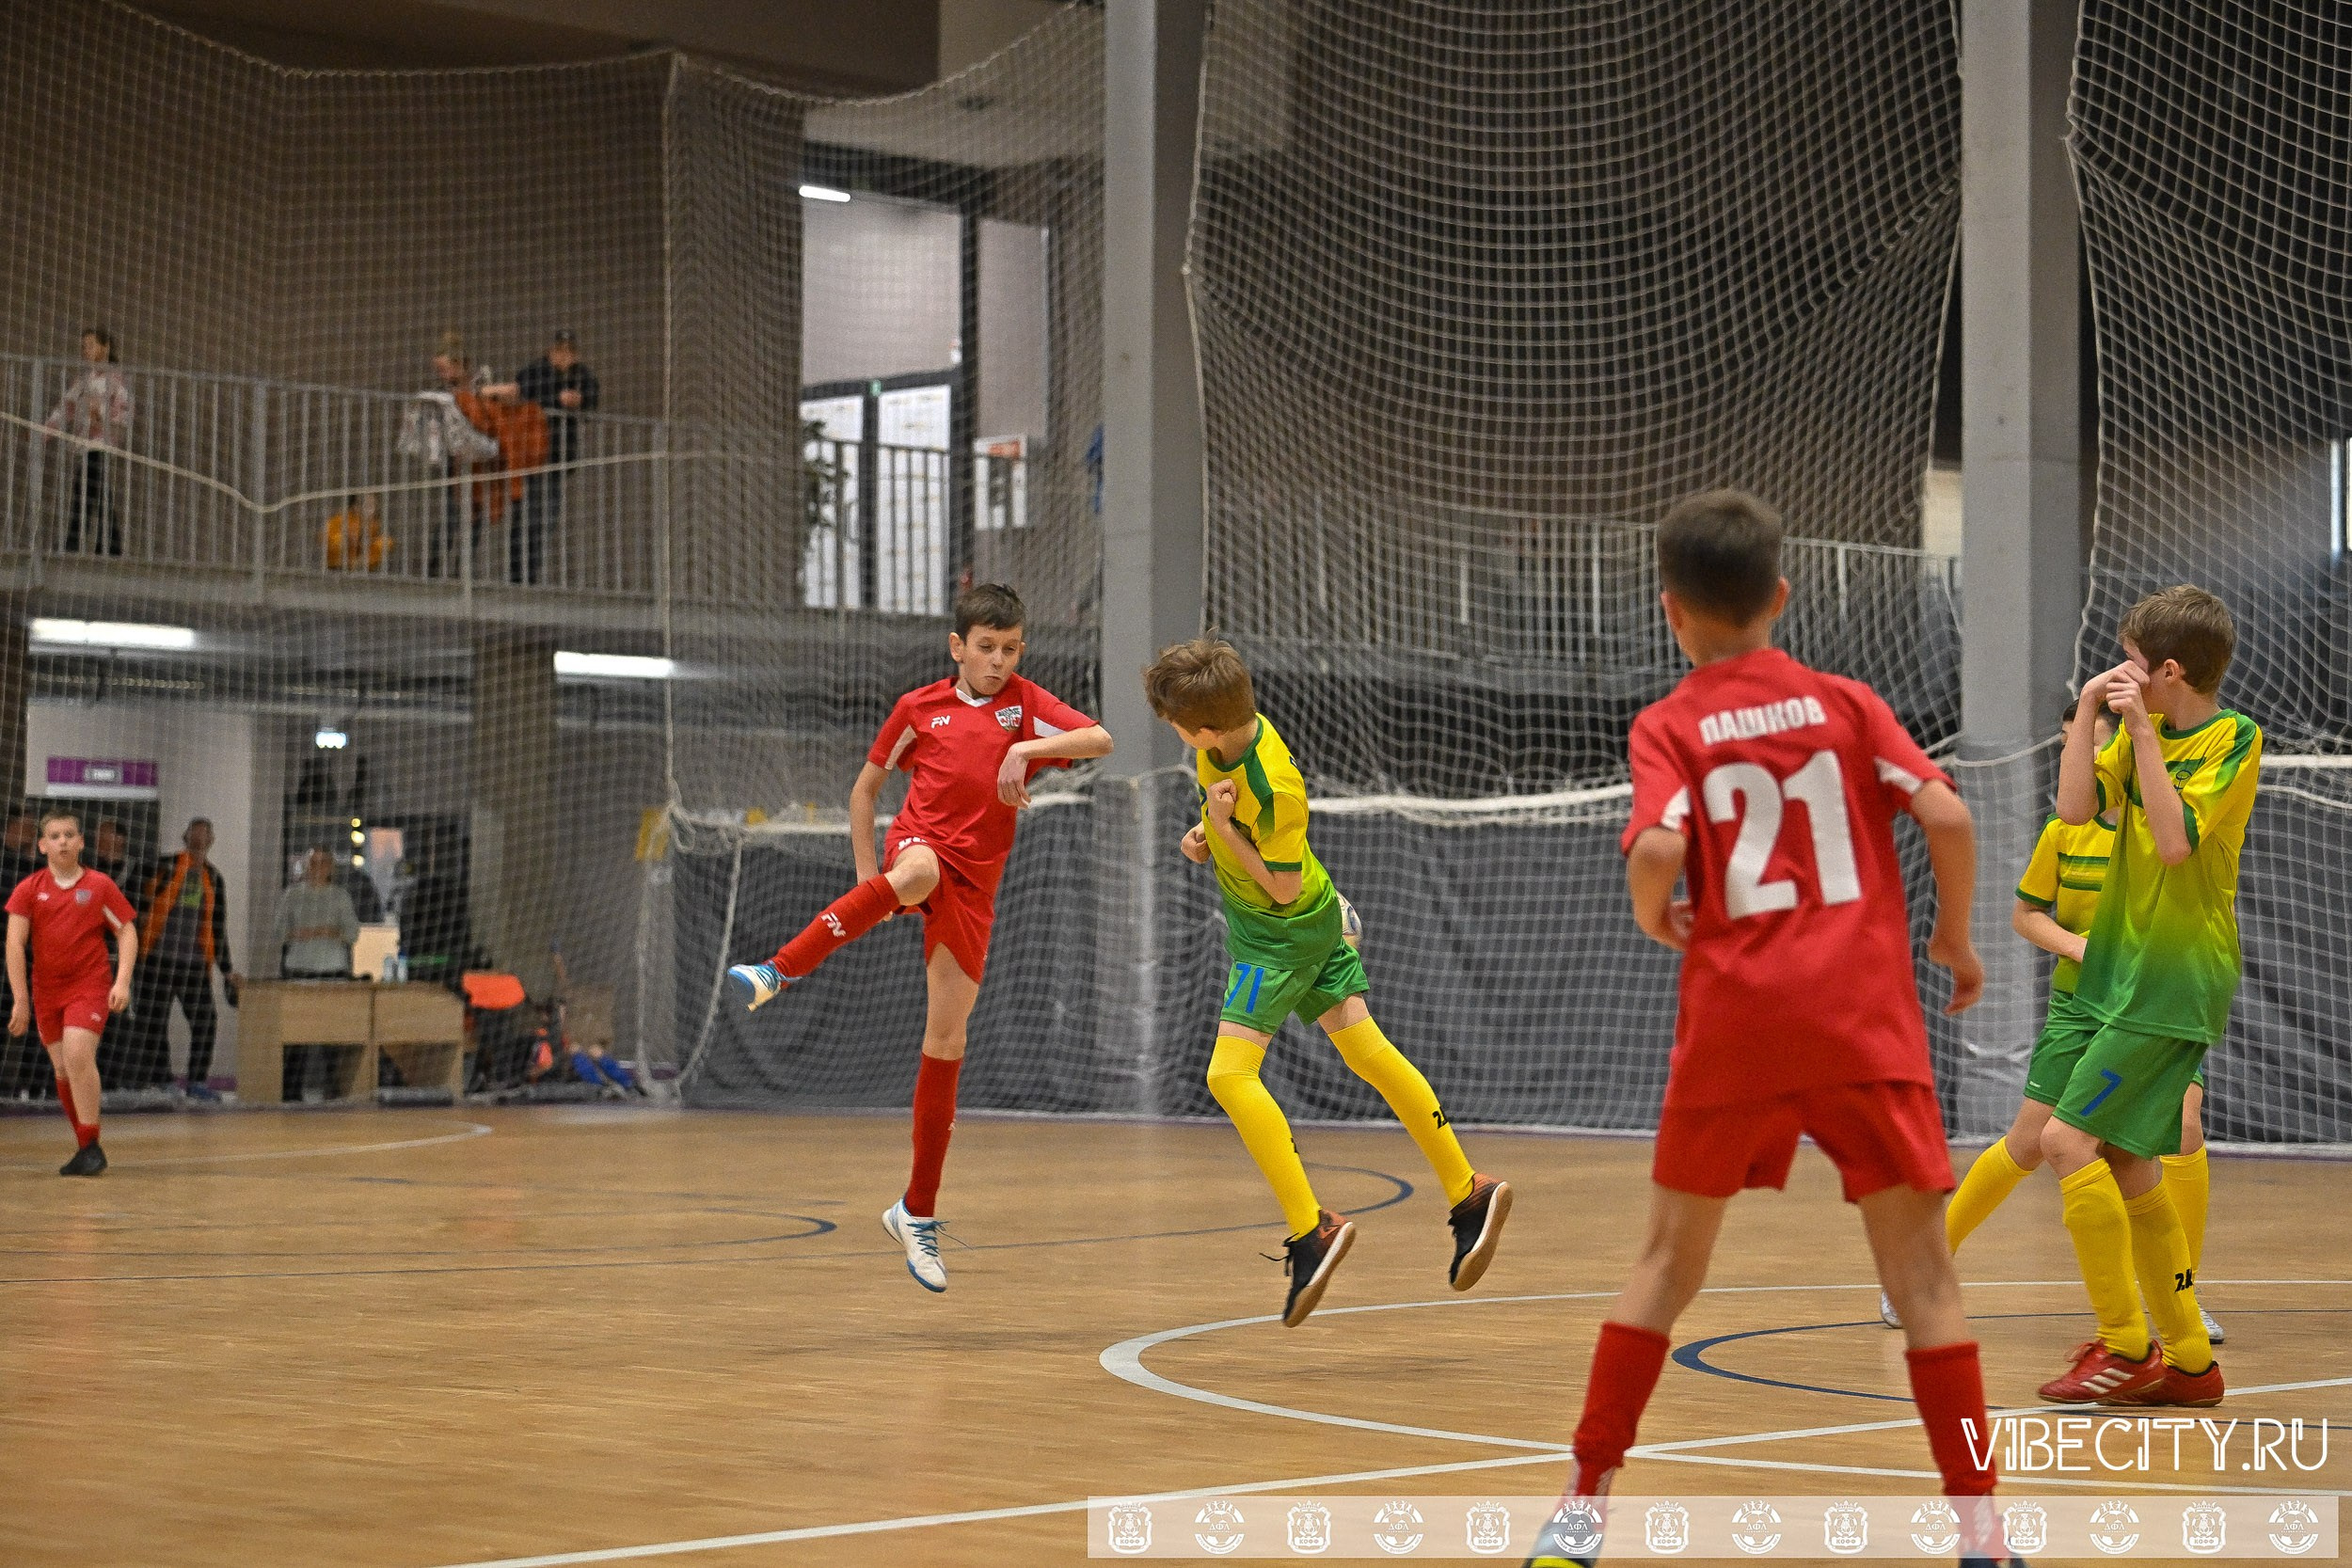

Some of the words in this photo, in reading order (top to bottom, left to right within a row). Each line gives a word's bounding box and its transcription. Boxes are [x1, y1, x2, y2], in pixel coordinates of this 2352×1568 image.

[1698, 695, 1827, 746] ПАШКОВ
[1703, 749, 1862, 920] 21
[1224, 962, 1264, 1014] 71
[2079, 1068, 2122, 1117] 7
